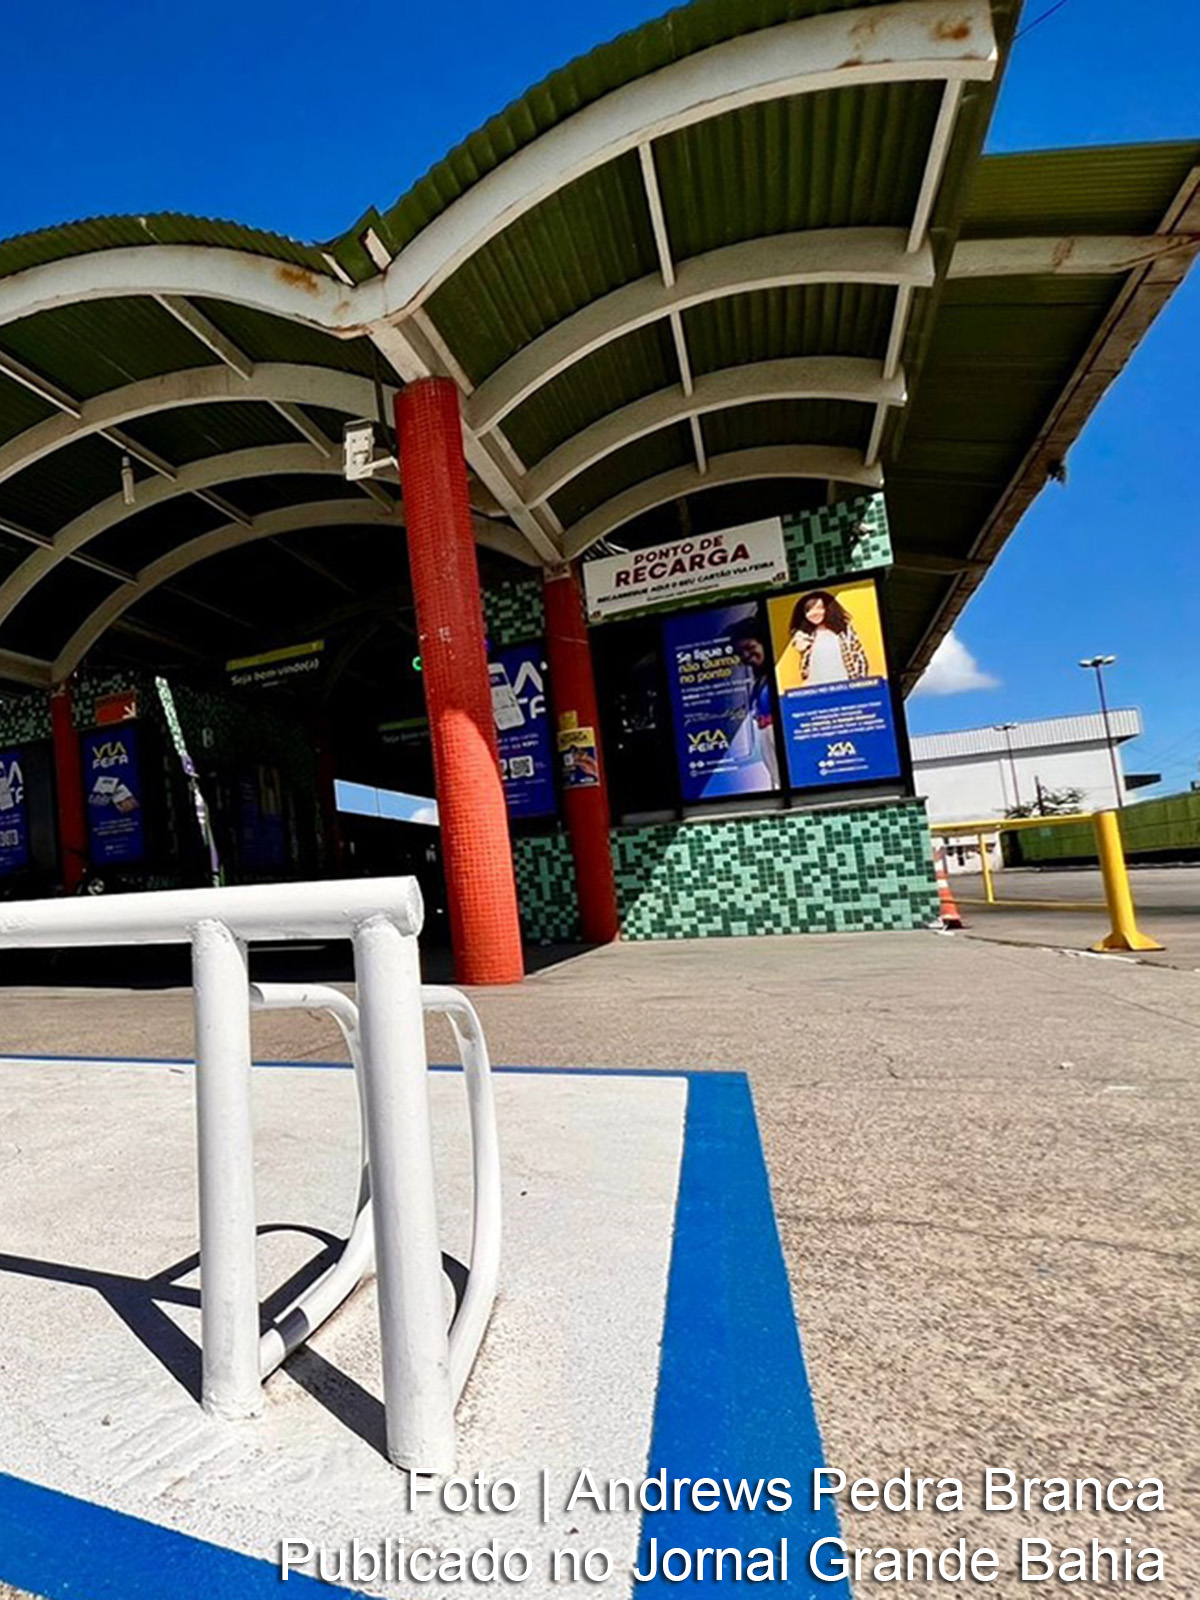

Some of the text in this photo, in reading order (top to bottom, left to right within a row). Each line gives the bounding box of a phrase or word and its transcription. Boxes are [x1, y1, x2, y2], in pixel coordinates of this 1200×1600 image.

[634, 534, 724, 566] PONTO DE
[615, 543, 750, 588] RECARGA
[697, 569, 731, 583] CARTÃO
[733, 565, 747, 575] VIA
[676, 645, 734, 664] Se ligue e
[678, 655, 741, 674] não durma
[680, 668, 732, 685] no ponto
